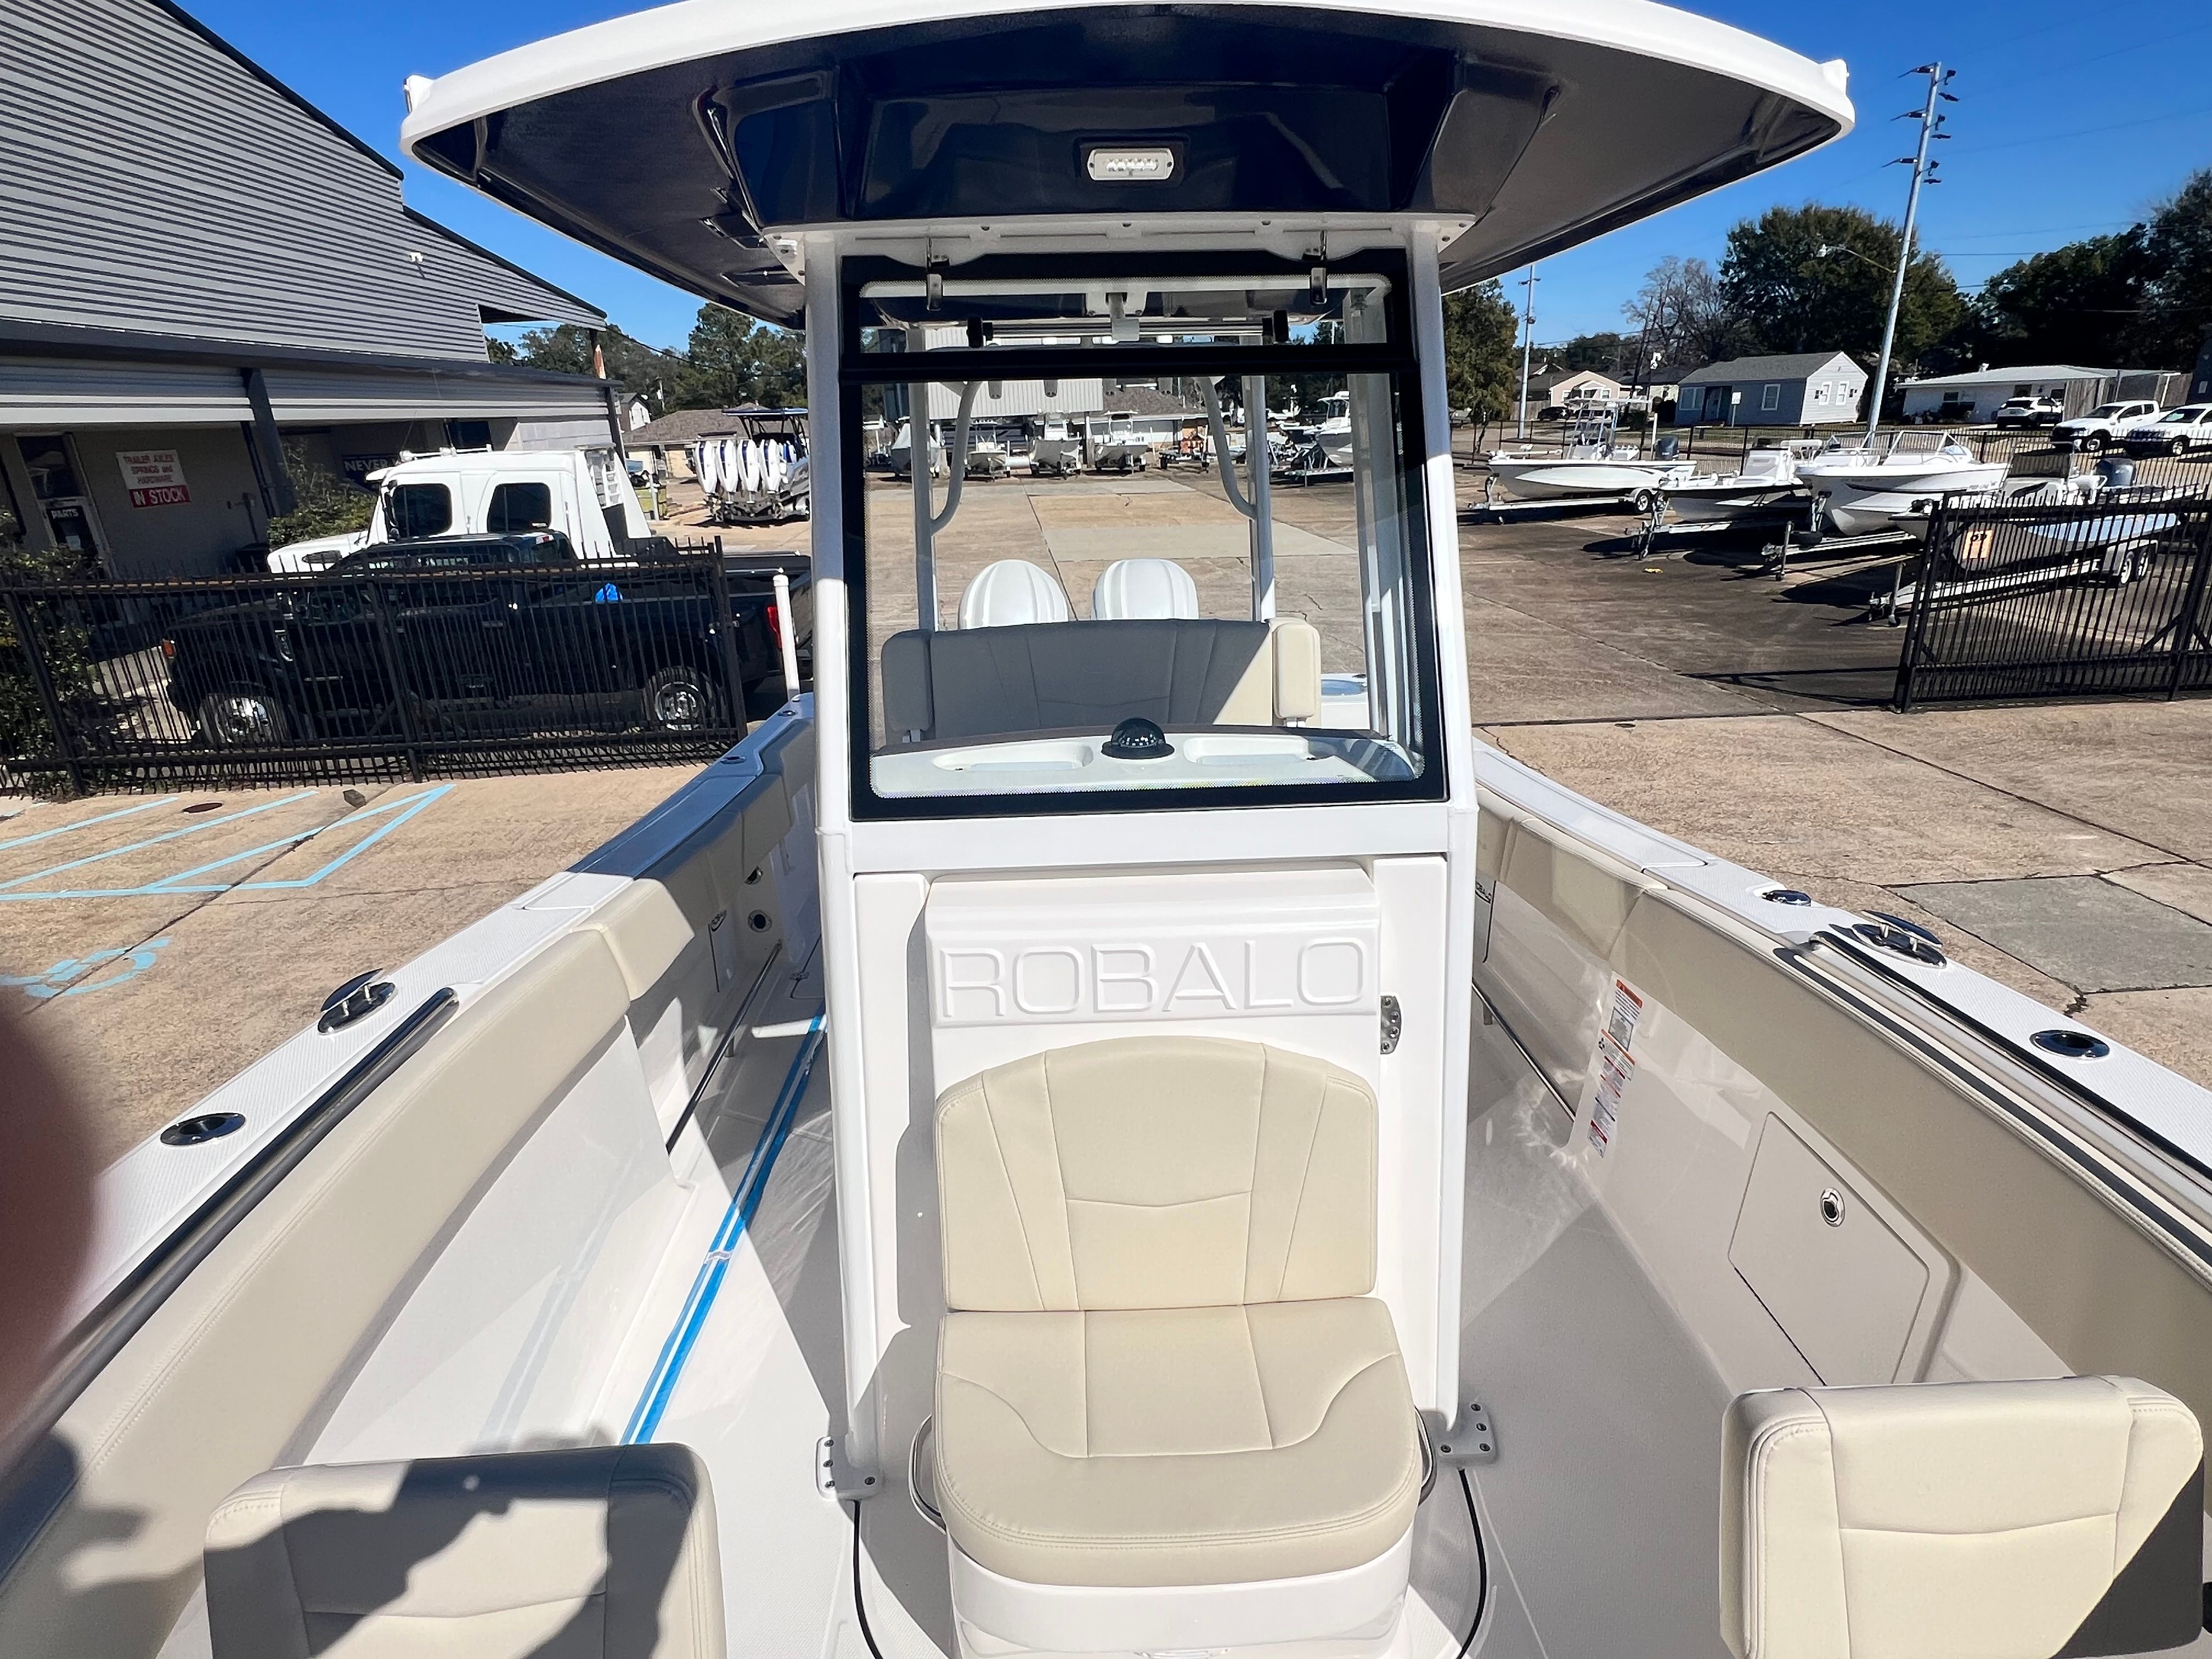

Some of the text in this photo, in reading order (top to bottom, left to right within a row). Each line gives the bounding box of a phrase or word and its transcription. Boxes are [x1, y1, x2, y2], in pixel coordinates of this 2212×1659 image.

[123, 454, 174, 464] TRAILER AXLES
[131, 466, 159, 475] SPRINGS
[344, 459, 388, 471] NEVER
[137, 475, 174, 484] HARDWARE
[133, 487, 185, 505] IN STOCK
[940, 937, 1365, 1018] ROBALO
